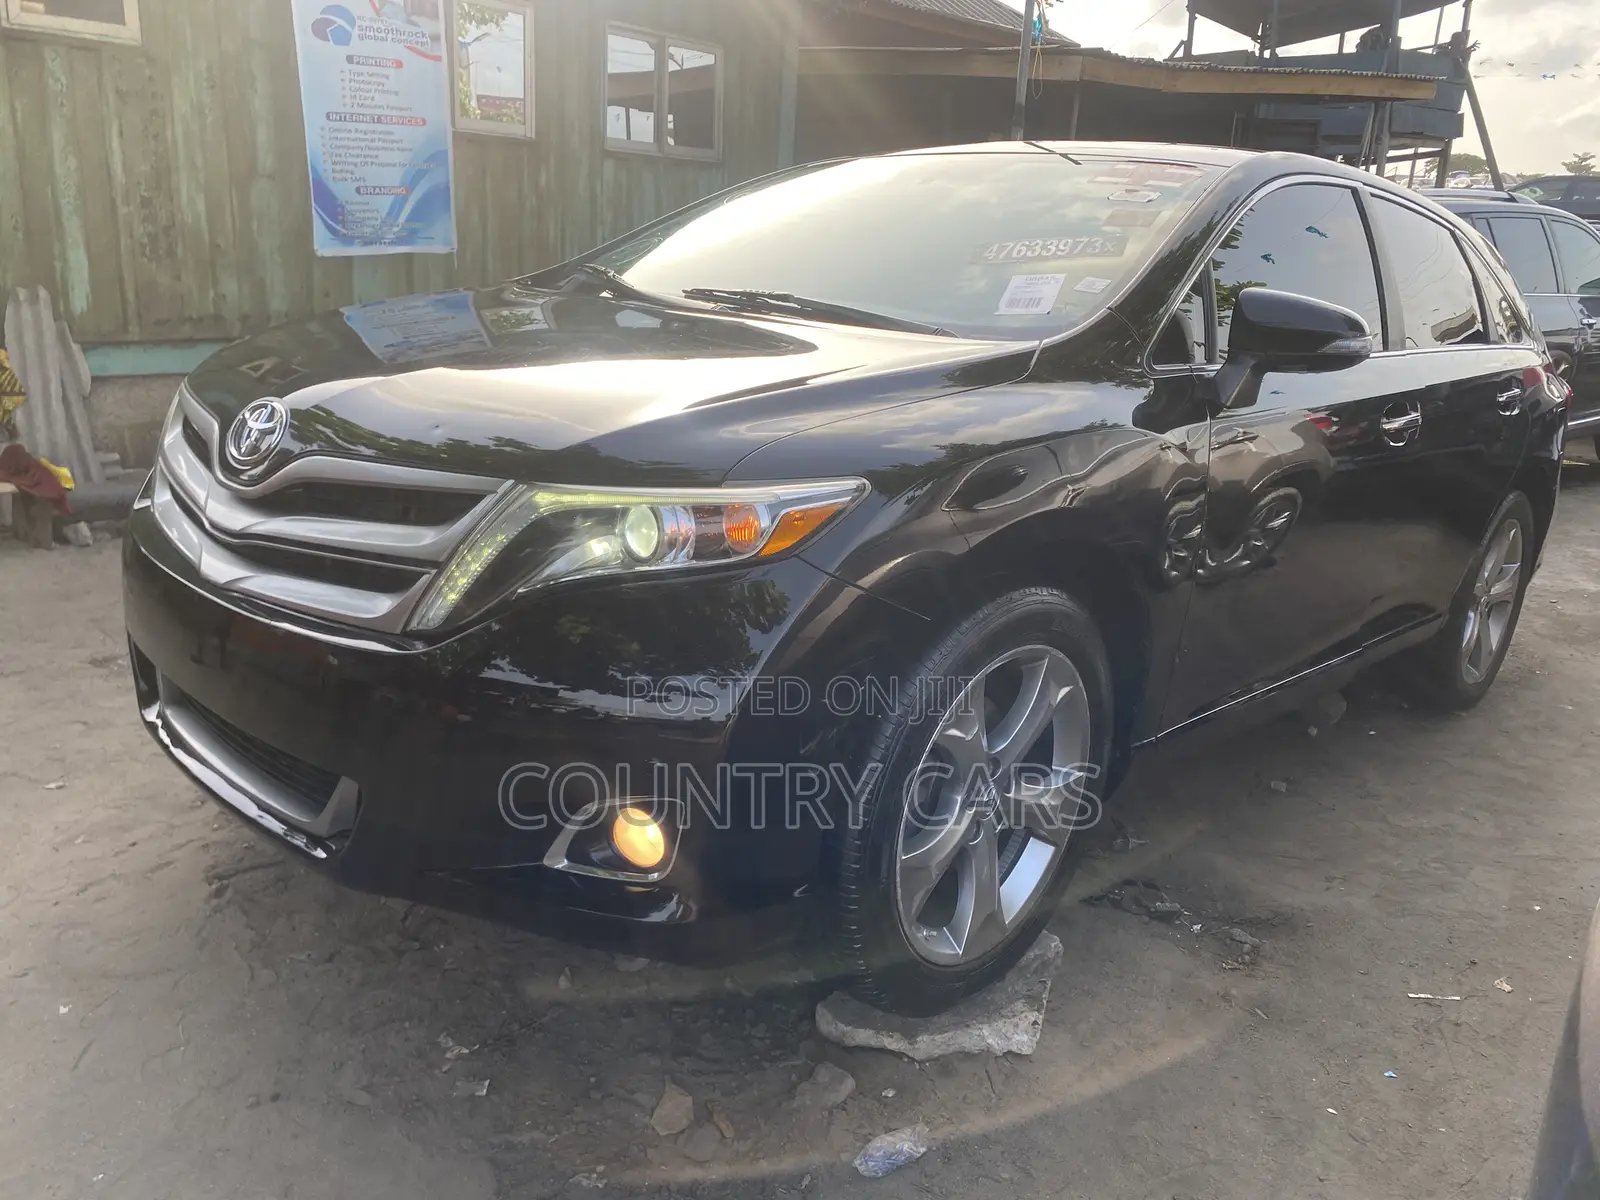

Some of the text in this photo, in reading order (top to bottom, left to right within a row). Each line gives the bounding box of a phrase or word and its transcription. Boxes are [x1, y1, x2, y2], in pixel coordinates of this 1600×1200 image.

[358, 24, 428, 39] smoothrock
[358, 33, 429, 47] global concept
[353, 55, 397, 67] PRINTING
[329, 112, 424, 126] INTERNET SERVICES
[360, 186, 407, 195] BRANDING
